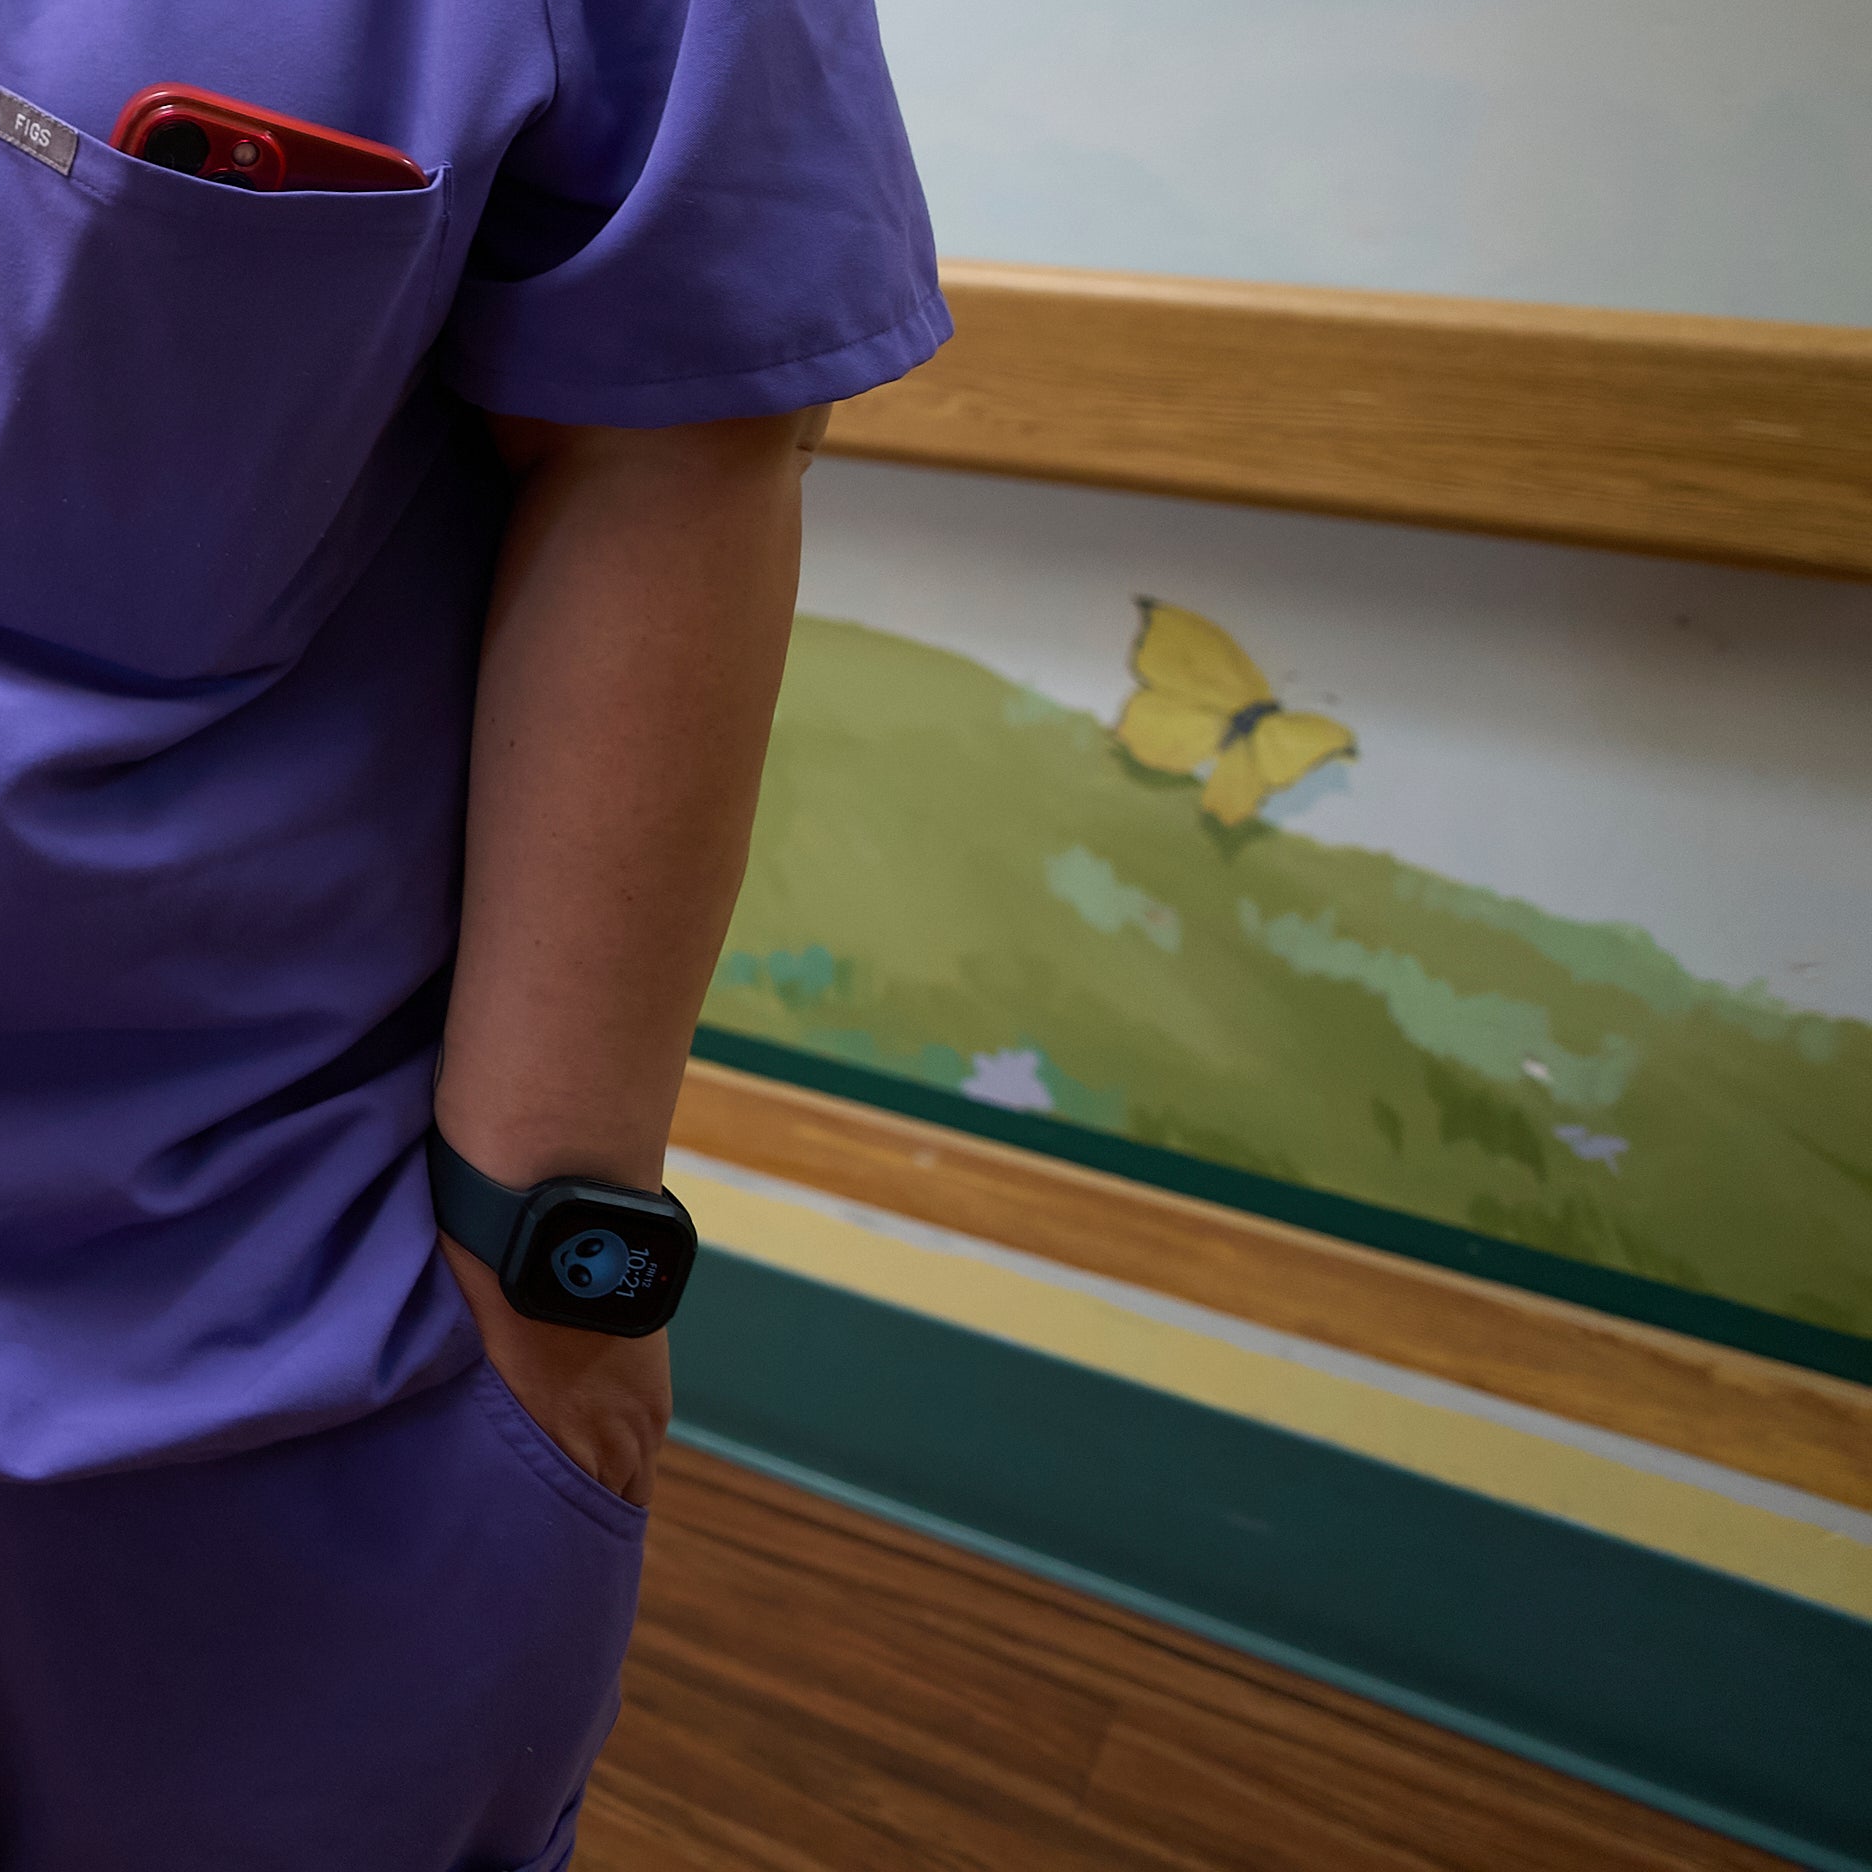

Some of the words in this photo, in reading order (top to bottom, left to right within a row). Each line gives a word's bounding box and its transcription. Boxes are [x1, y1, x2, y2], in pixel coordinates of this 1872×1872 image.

[14, 113, 53, 148] FIGS
[616, 1248, 650, 1298] 10:21
[646, 1262, 658, 1278] FRI
